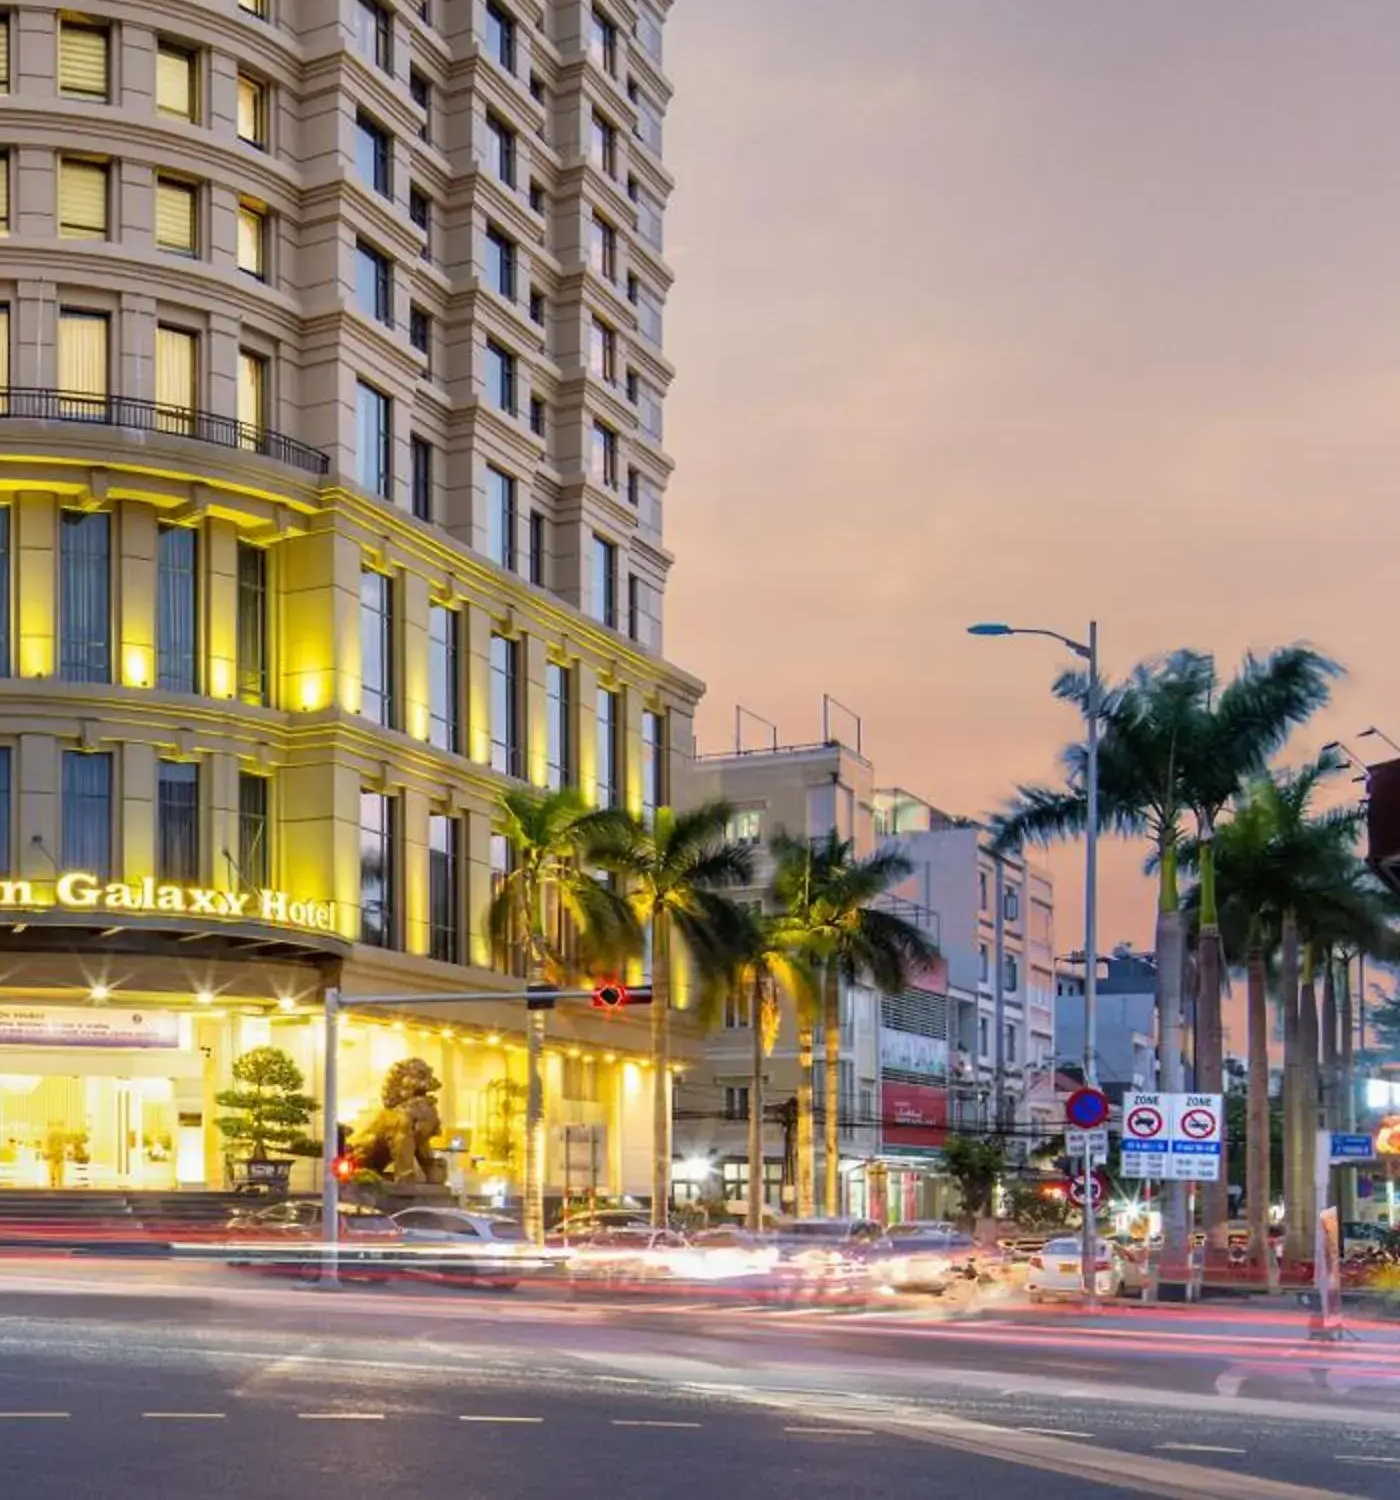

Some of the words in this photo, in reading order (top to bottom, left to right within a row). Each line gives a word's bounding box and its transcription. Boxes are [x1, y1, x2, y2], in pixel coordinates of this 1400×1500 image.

[56, 871, 250, 917] Galaxy
[259, 887, 338, 932] Hotel
[1134, 1095, 1160, 1106] ZONE
